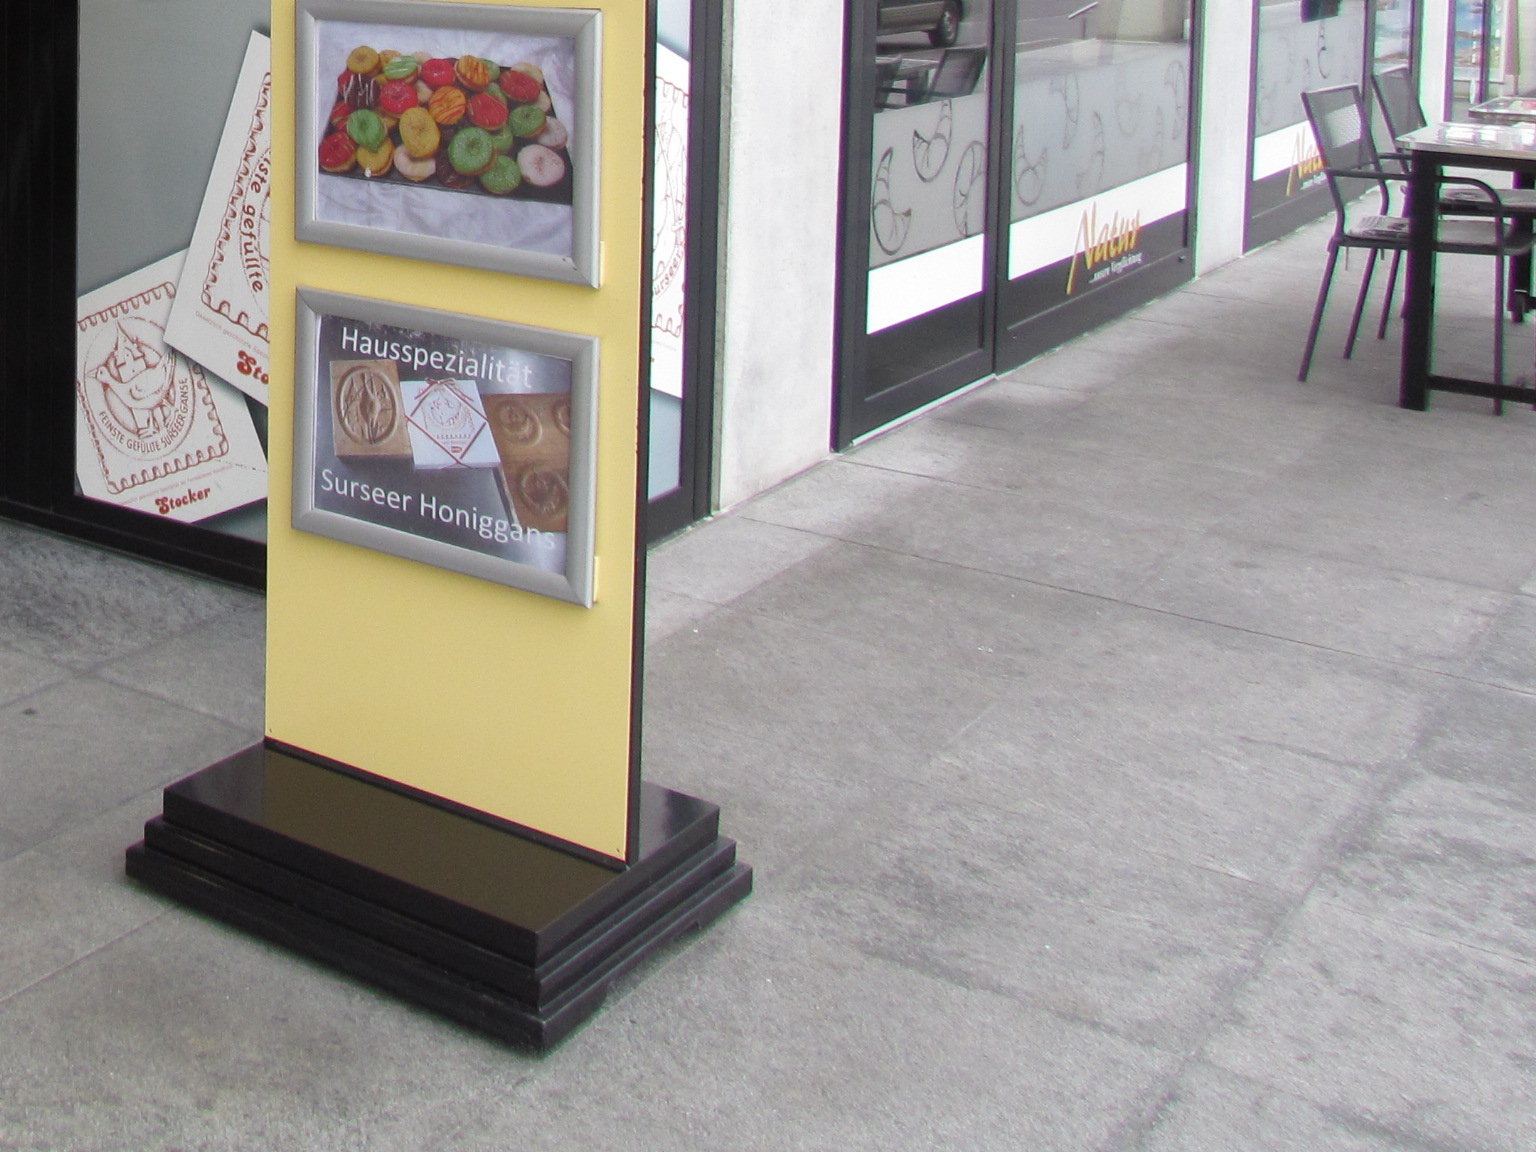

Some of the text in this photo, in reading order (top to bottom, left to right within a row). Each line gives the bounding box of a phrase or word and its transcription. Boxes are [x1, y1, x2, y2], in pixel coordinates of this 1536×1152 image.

[341, 326, 533, 389] Hausspezialität
[98, 410, 126, 445] FEINSTE
[154, 487, 211, 515] Stocker
[321, 468, 556, 550] Surseer Honiggans
